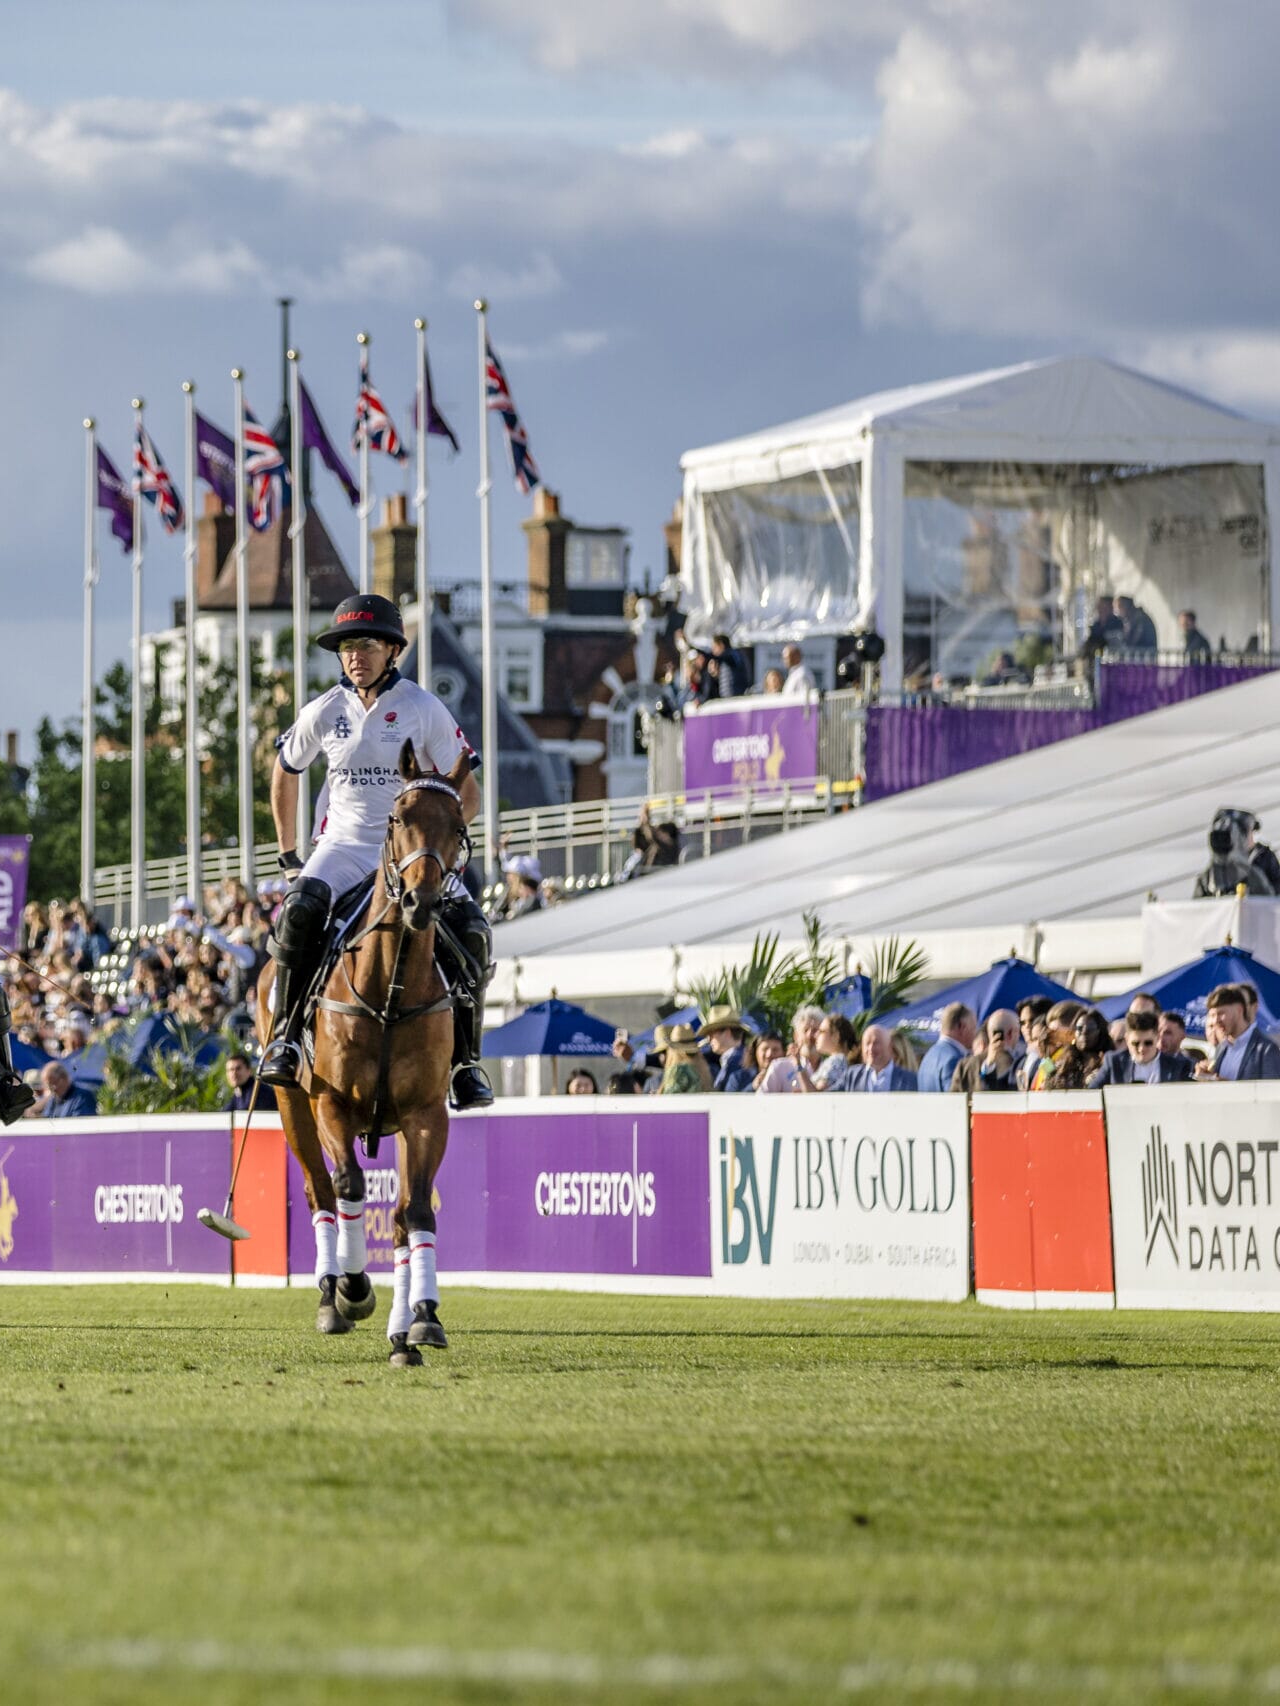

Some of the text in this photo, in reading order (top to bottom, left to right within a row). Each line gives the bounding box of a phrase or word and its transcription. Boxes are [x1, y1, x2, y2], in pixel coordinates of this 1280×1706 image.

[352, 777, 386, 786] POLO
[535, 1171, 656, 1217] CHESTERTONS
[793, 1135, 956, 1213] IBV GOLD
[94, 1183, 183, 1224] CHESTERTONS
[1189, 1226, 1261, 1271] DATA
